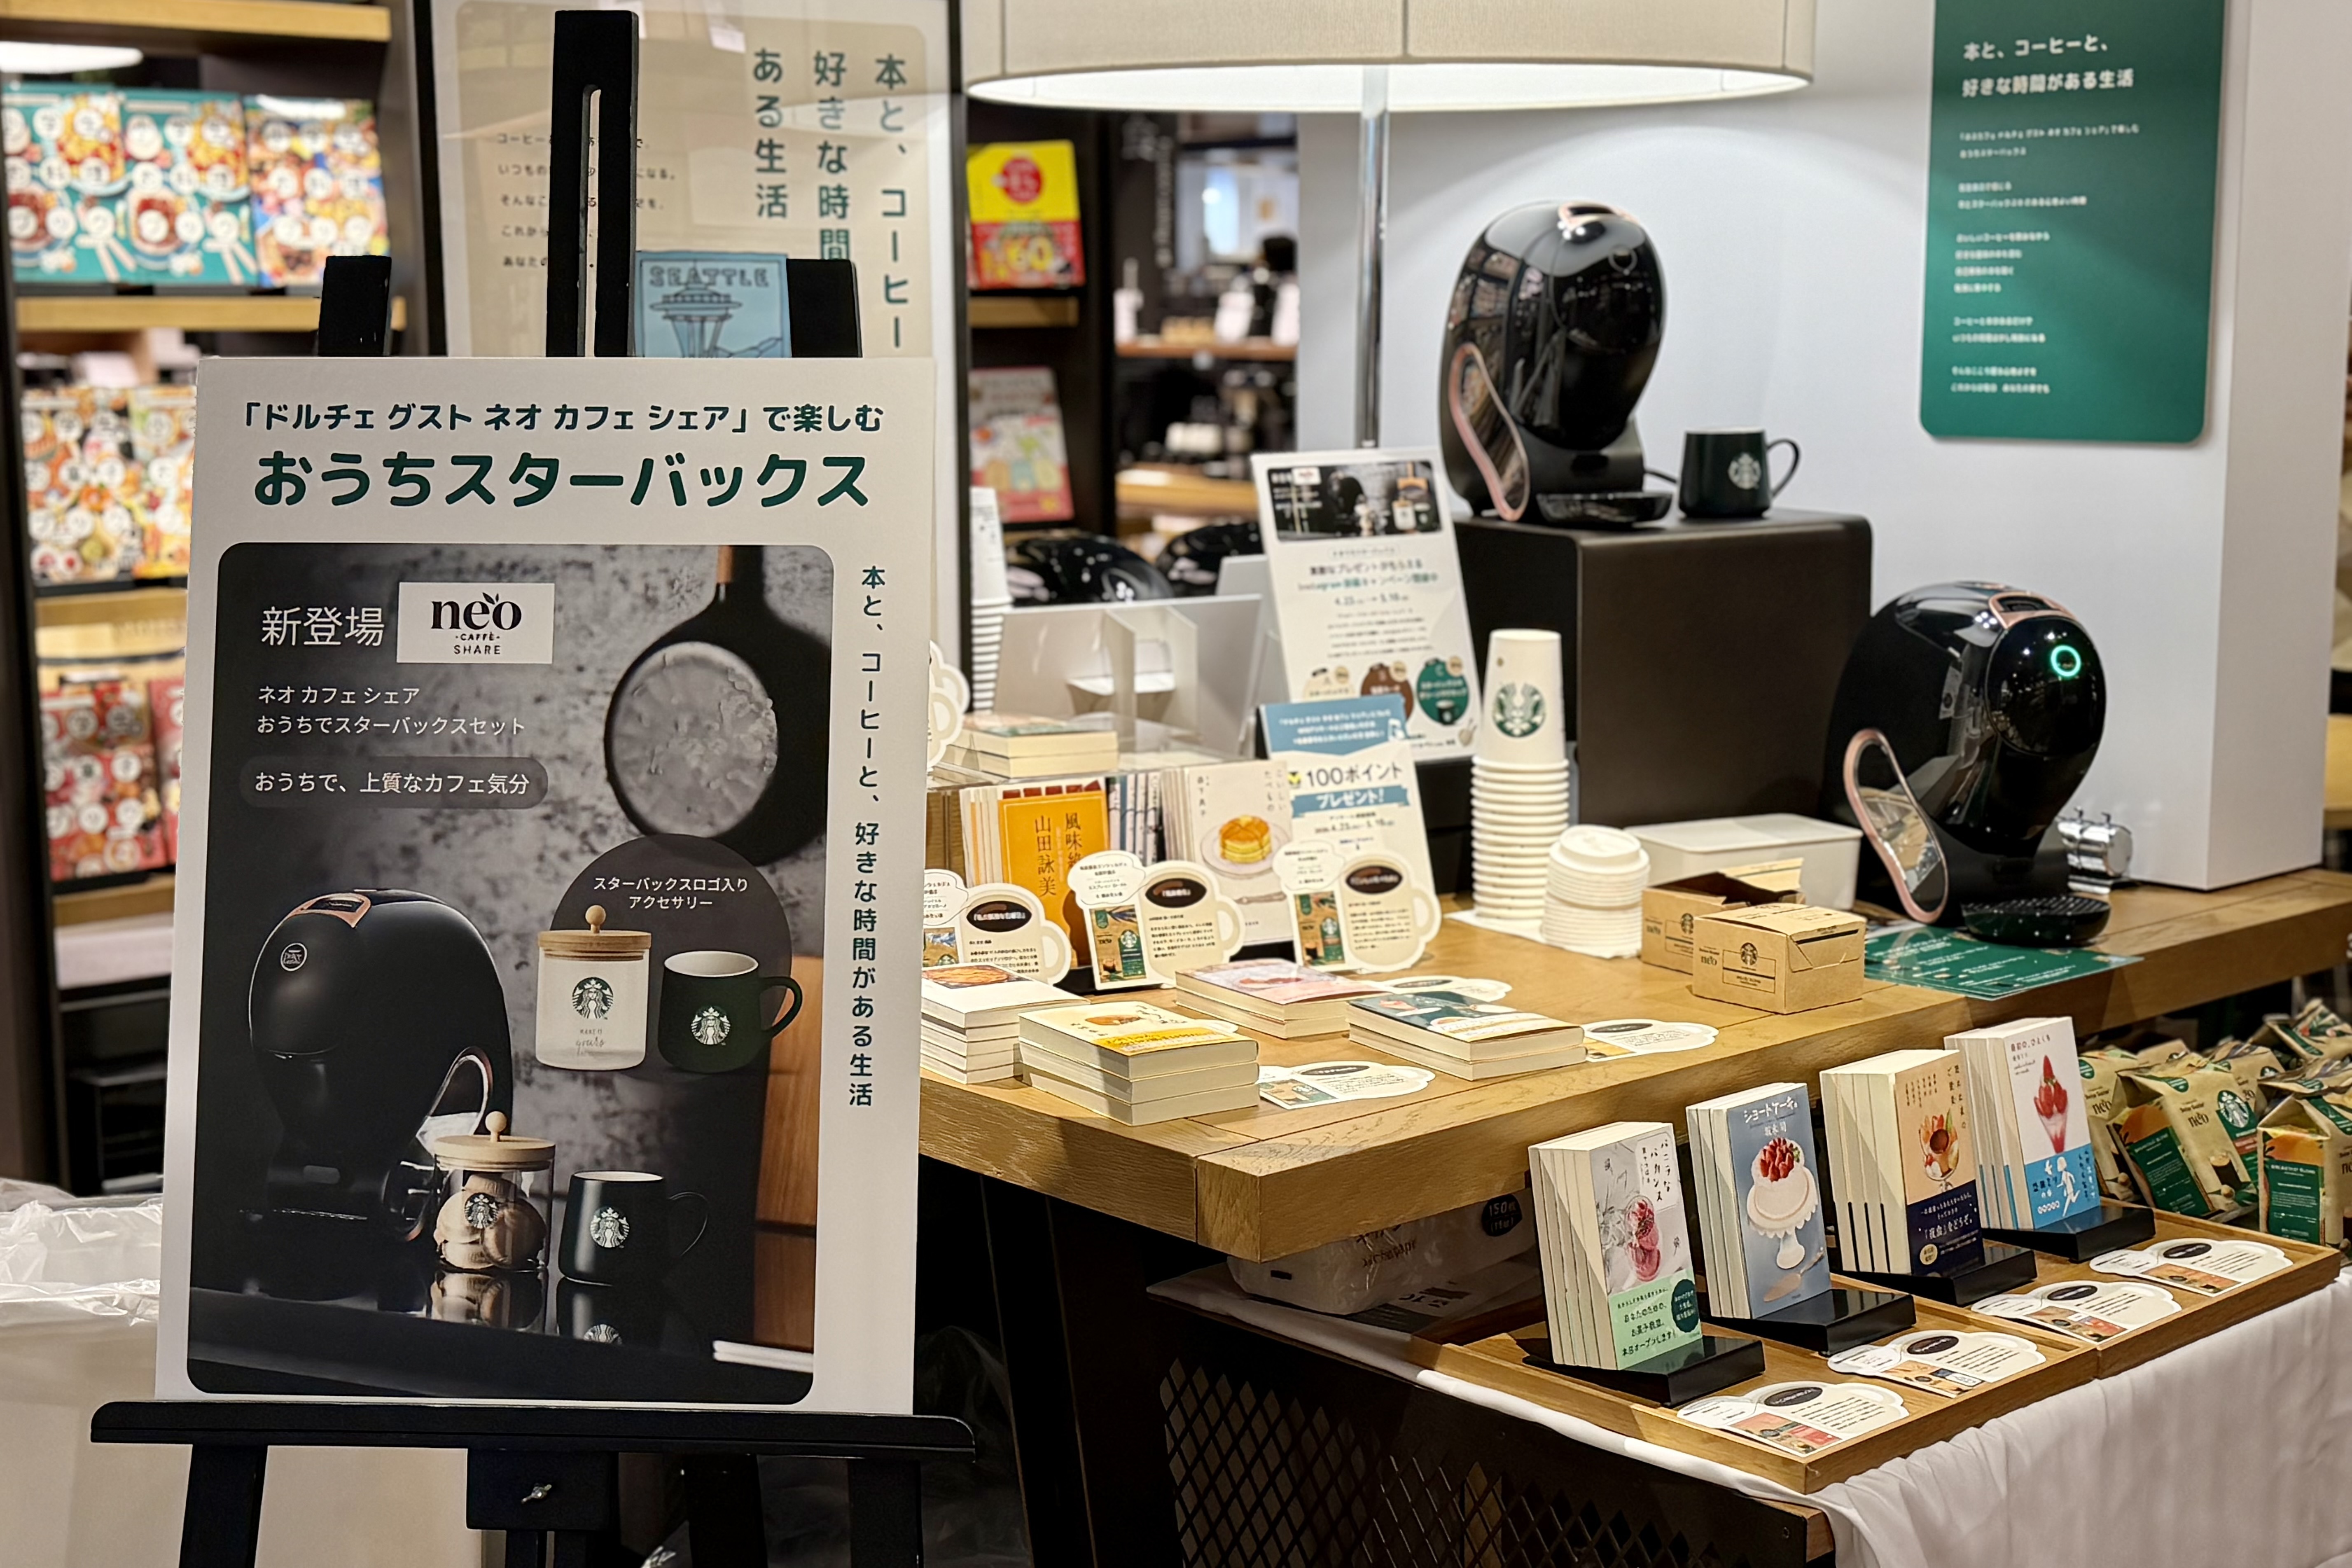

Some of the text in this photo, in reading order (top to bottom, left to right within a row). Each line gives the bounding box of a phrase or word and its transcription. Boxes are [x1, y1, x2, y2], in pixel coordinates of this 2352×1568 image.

[753, 48, 788, 219] ある生活
[649, 265, 769, 287] SEATTLE
[388, 403, 472, 430] グスト
[484, 403, 542, 430] ネオ
[554, 404, 633, 430] カフェ
[254, 450, 869, 507] おうちスターバックス
[430, 596, 522, 630] neo
[261, 606, 385, 647] 新登場
[453, 644, 501, 655] SHARE
[259, 687, 420, 705] ネオ カフェ シェア
[257, 715, 525, 736] おうちでスターバックスセット
[255, 772, 530, 795] おうちで、上質なカフェ気分
[1307, 762, 1402, 787] 100ポイント
[1035, 815, 1057, 897] 山田詠美
[594, 877, 748, 892] スターバックスロゴ入り
[629, 895, 713, 909] アクセサリー
[1701, 955, 1717, 967] neo
[2093, 1098, 2112, 1115] neo
[2188, 1112, 2209, 1128] neo
